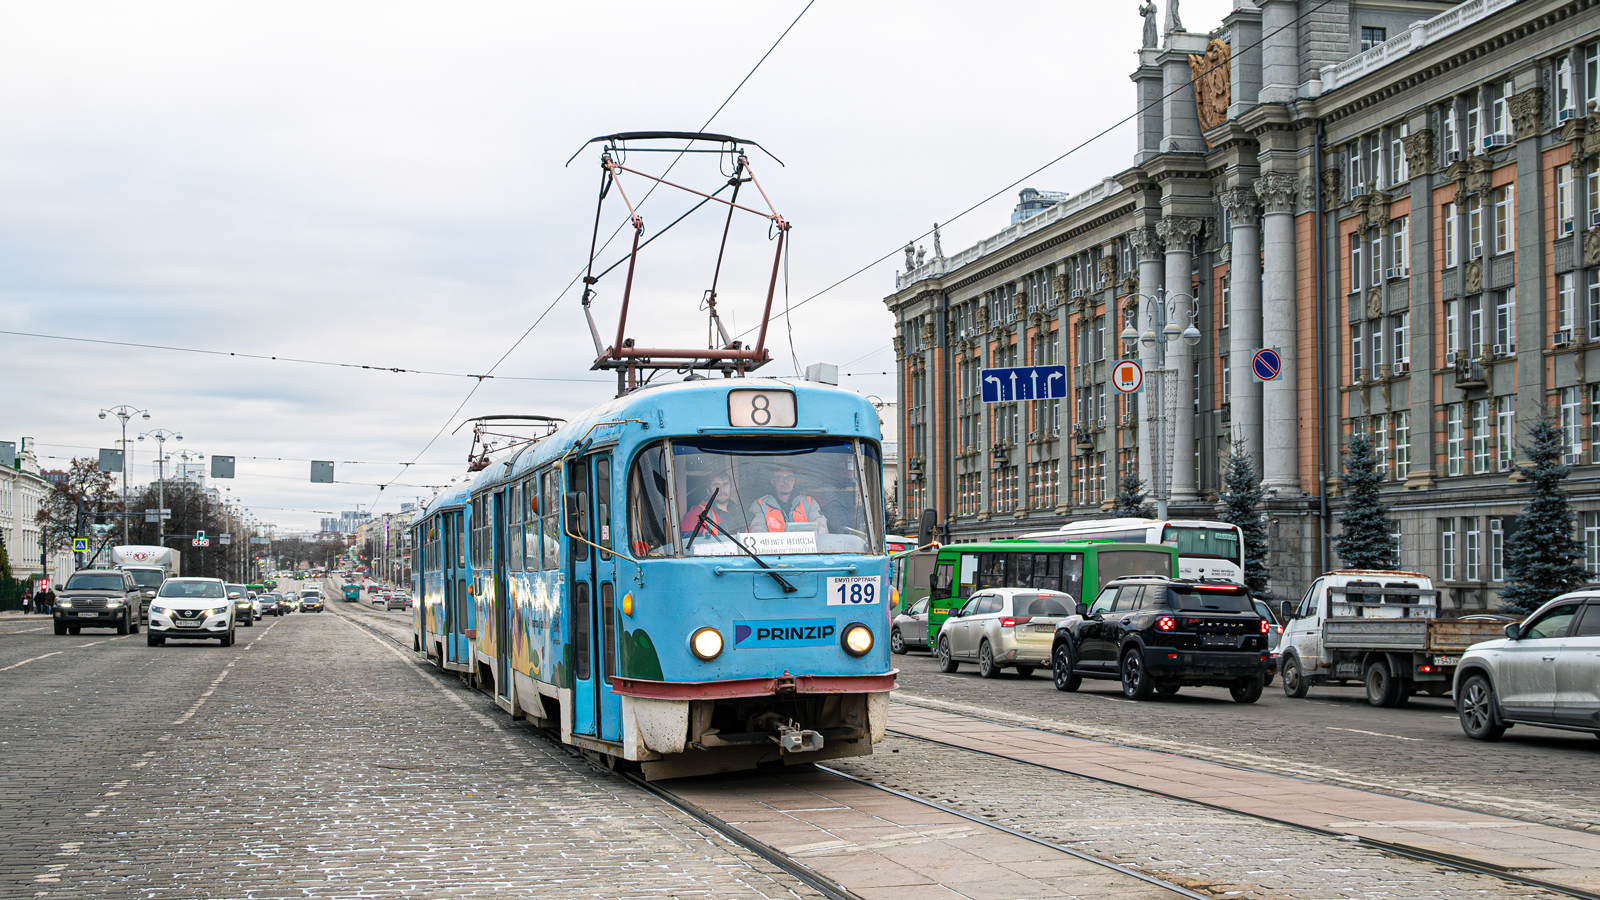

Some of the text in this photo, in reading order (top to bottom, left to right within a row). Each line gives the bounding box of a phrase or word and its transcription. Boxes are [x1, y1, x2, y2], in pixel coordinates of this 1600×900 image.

[751, 394, 771, 426] 8
[837, 583, 875, 604] 189
[757, 625, 835, 641] PRINZIP
